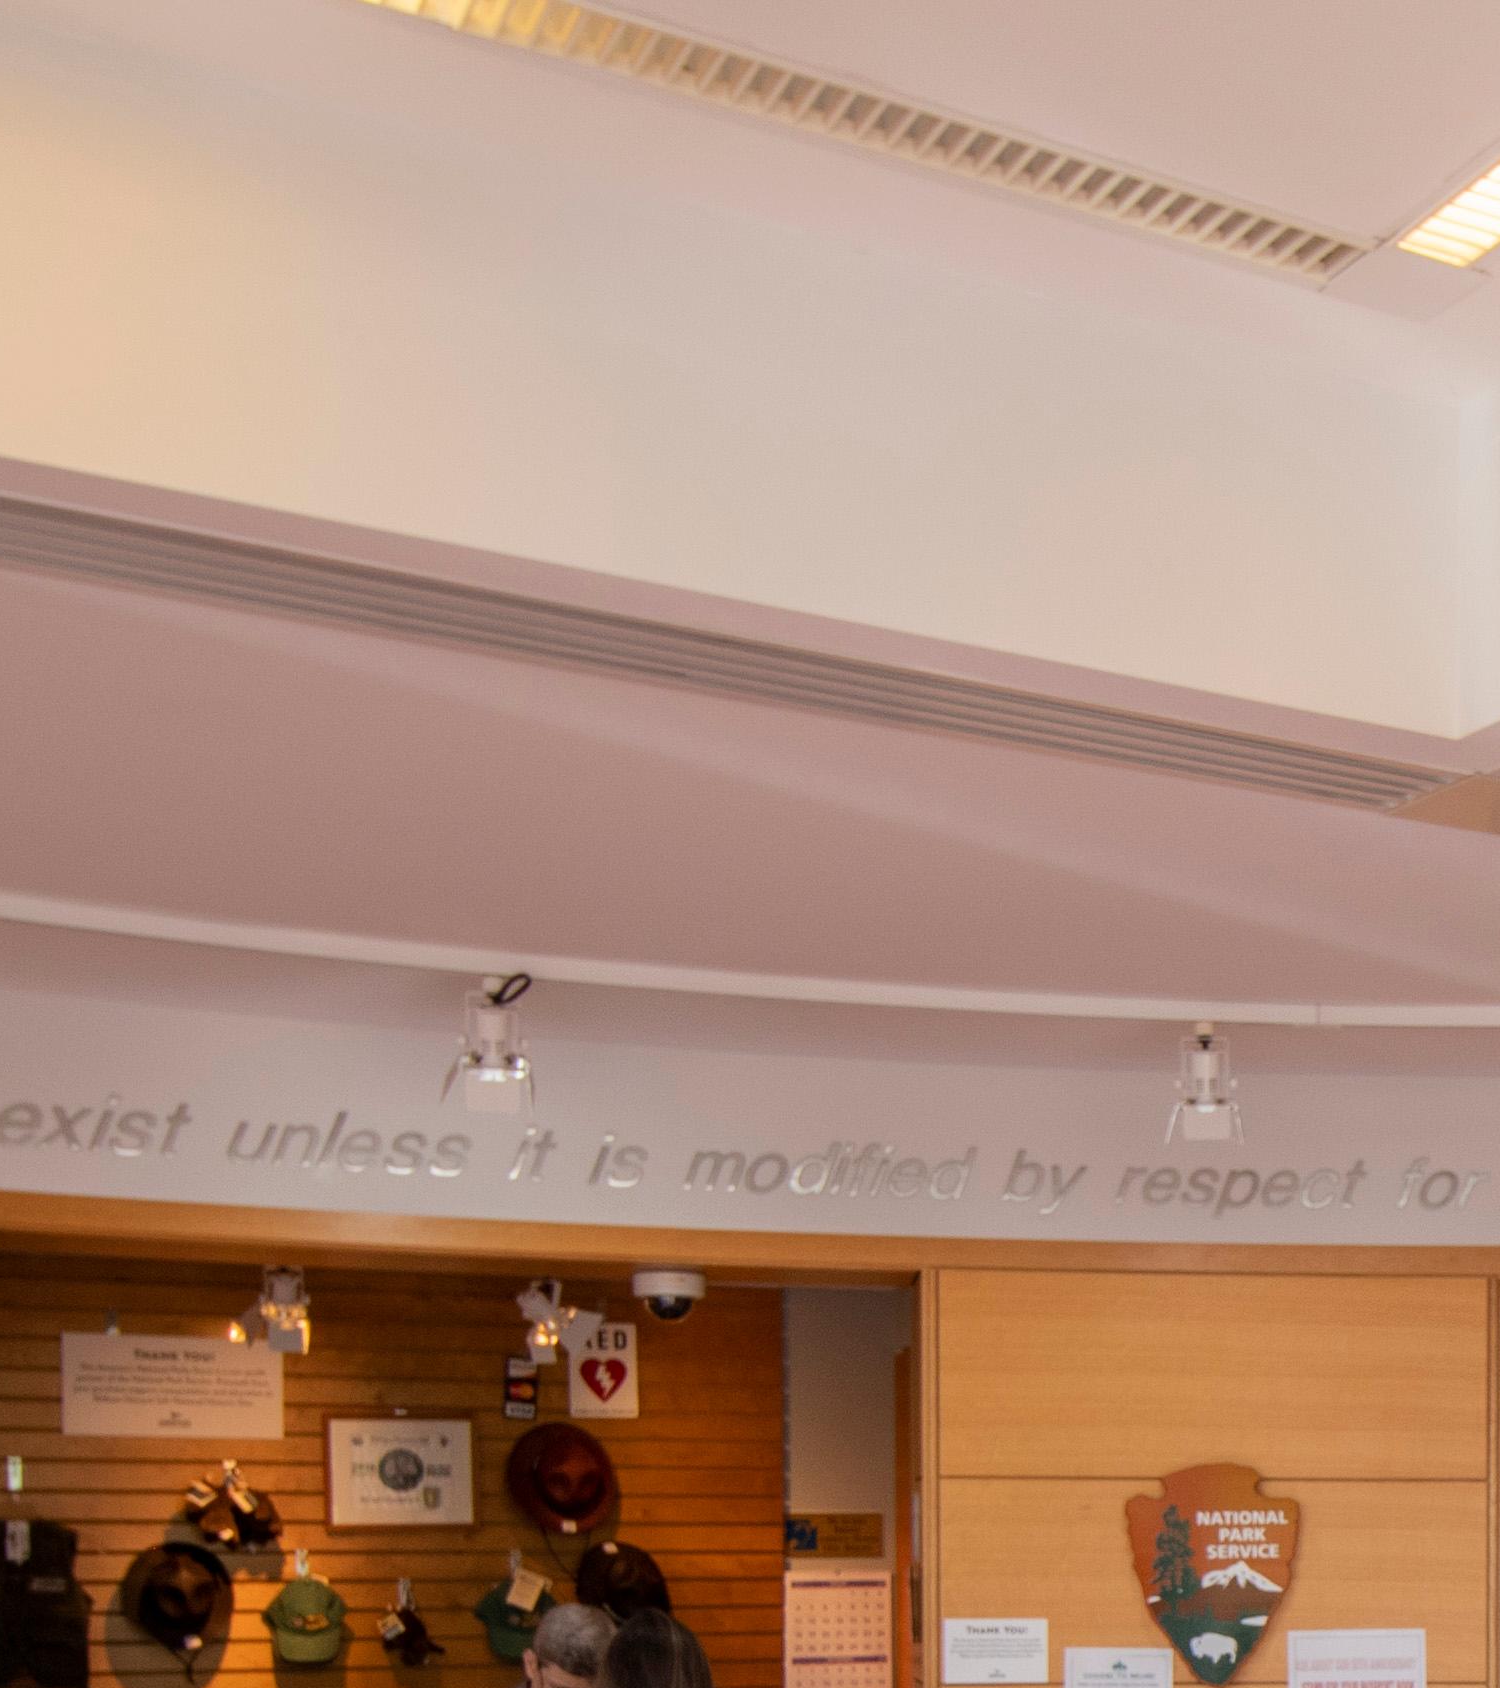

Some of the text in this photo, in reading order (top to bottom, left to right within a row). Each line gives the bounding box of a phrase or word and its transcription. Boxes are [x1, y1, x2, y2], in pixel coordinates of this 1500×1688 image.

[226, 1110, 472, 1180] unless
[507, 1127, 559, 1185] it
[590, 1133, 647, 1189] is
[683, 1139, 978, 1202] modified
[1004, 1148, 1089, 1217] by
[1117, 1158, 1368, 1219] respect
[1395, 1155, 1490, 1212] for
[586, 1329, 628, 1349] ED
[1195, 1510, 1288, 1526] NATIONAL
[1219, 1528, 1266, 1542] PARK
[1206, 1544, 1279, 1559] SERVICE
